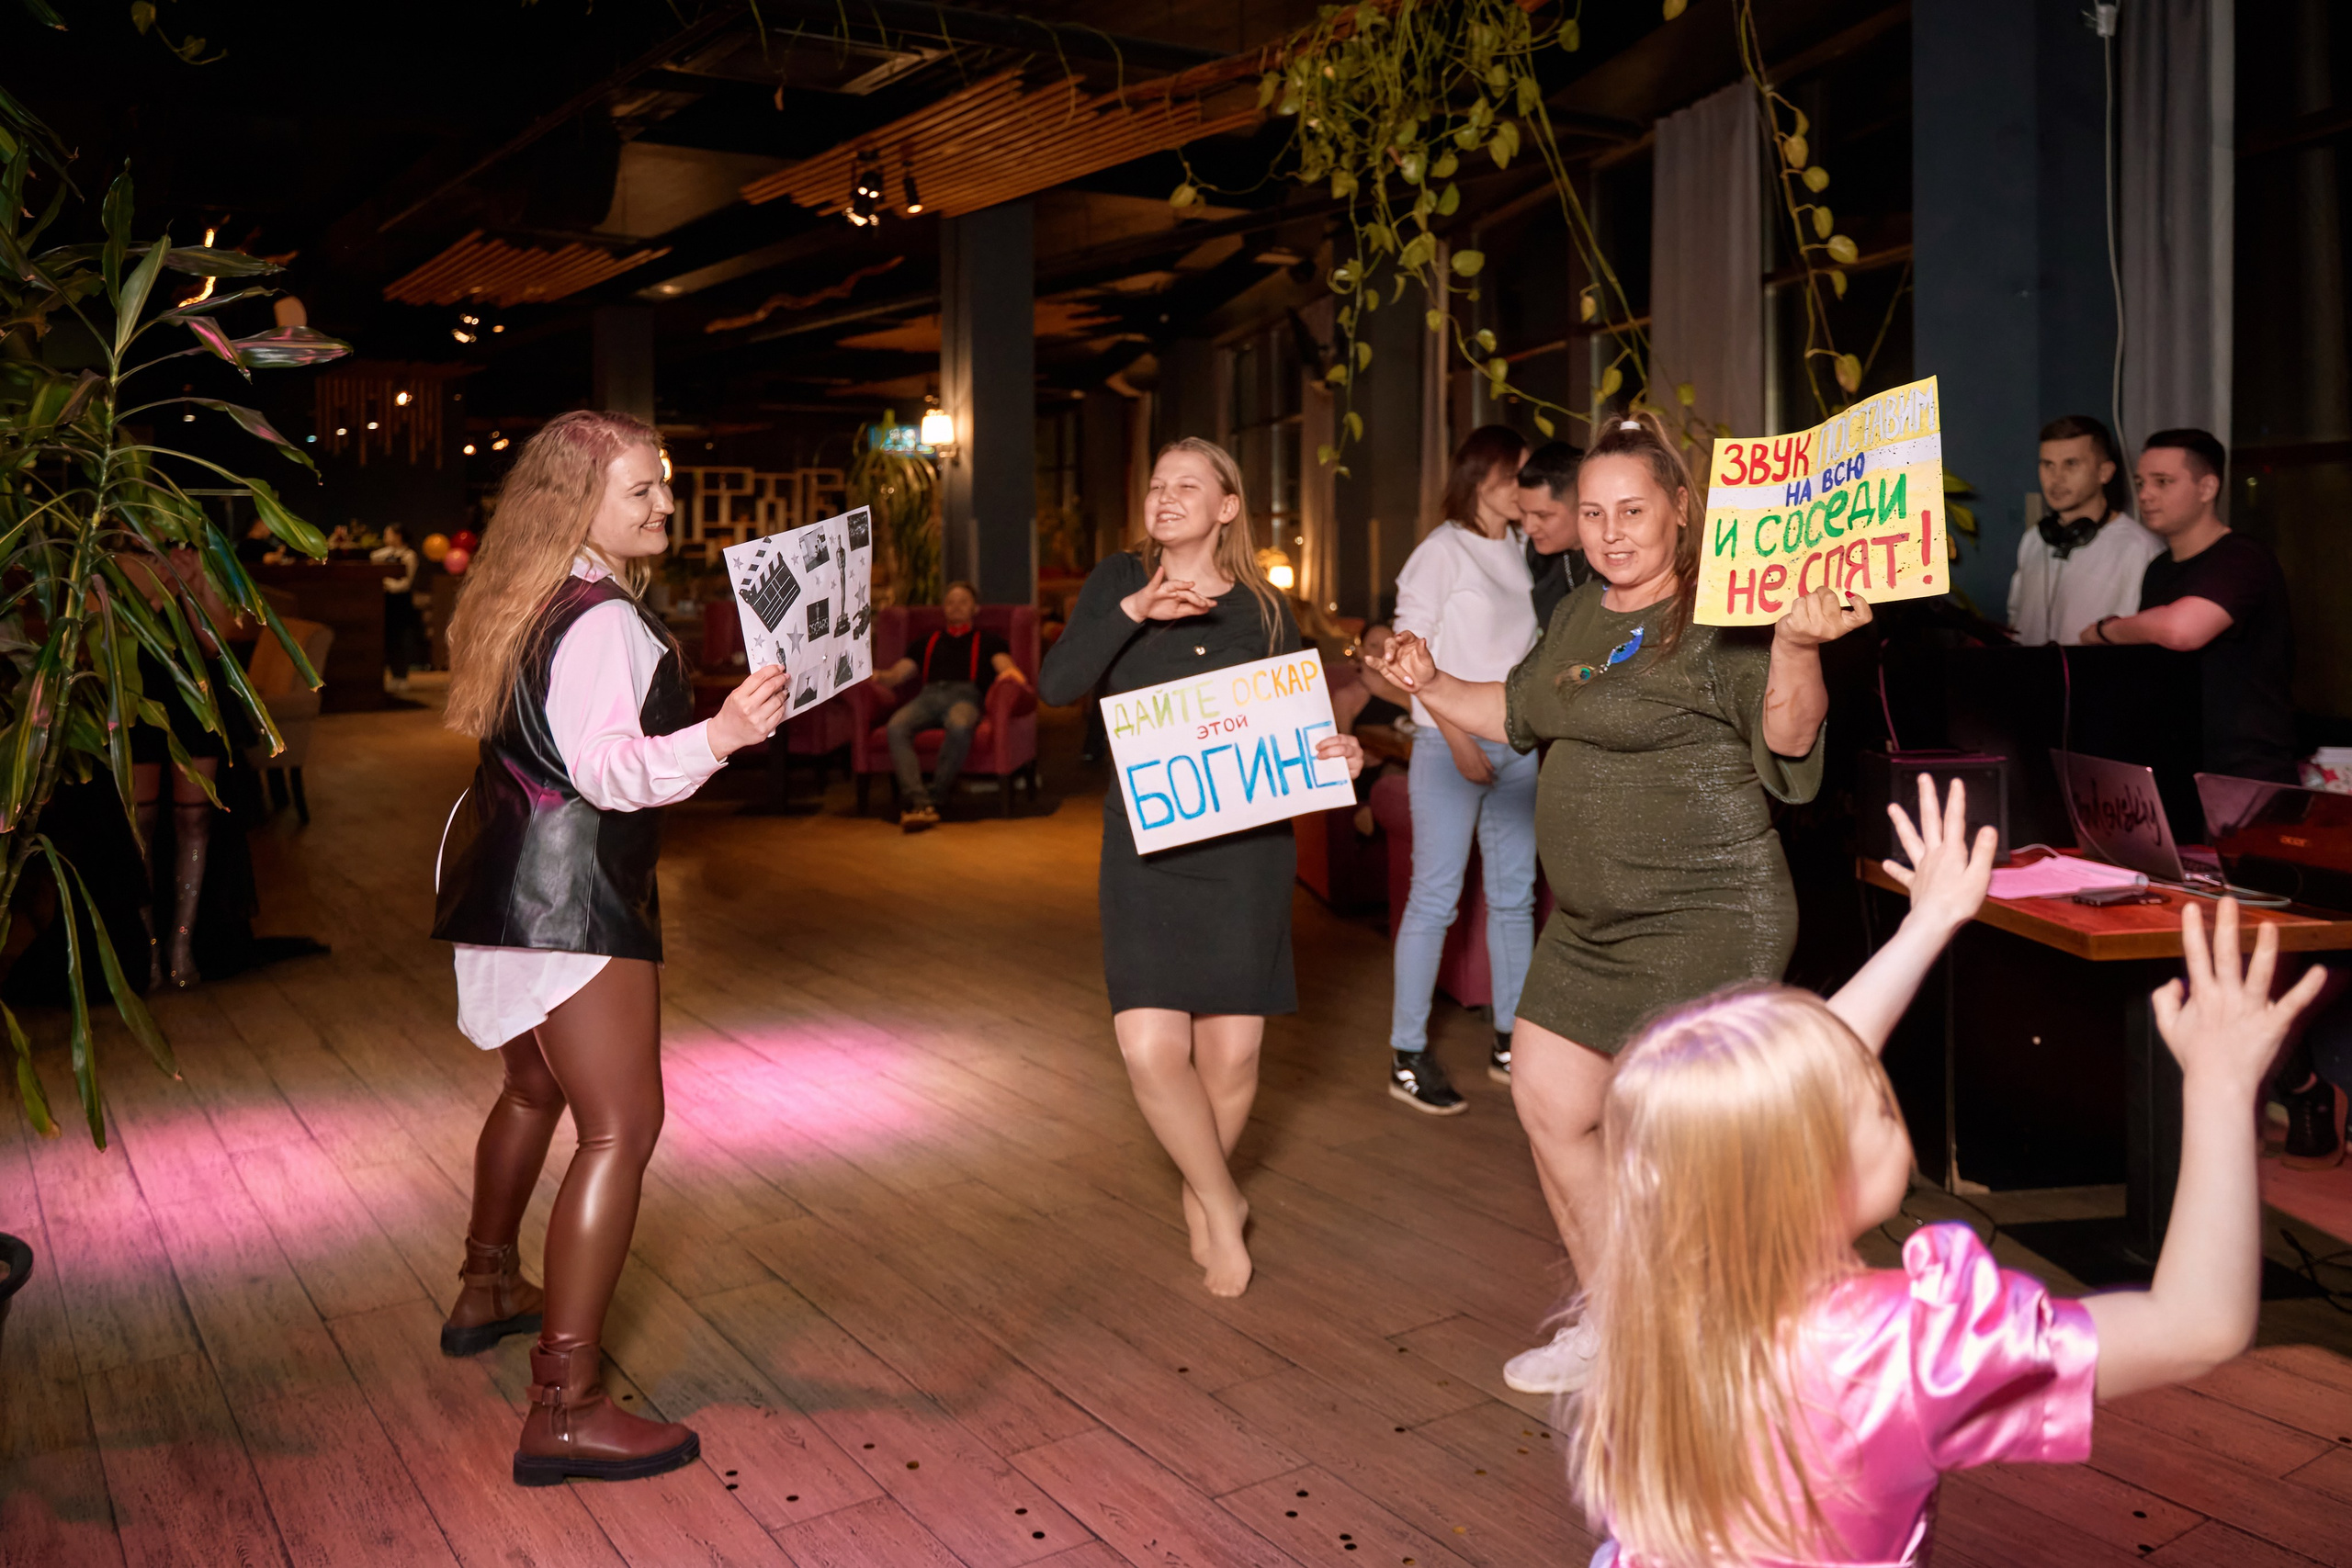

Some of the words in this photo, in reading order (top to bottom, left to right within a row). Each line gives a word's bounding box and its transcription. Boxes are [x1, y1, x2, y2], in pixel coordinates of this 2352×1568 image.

[1721, 433, 1812, 486] ЗВУК
[1816, 383, 1936, 470] ПОСТАВИМ
[1785, 478, 1812, 507] НА
[1822, 452, 1866, 492] ВСЮ
[1114, 680, 1221, 739] ДАЙТЕ
[1231, 660, 1318, 707] ОСКАР
[1126, 720, 1348, 830] БОГИНЕ
